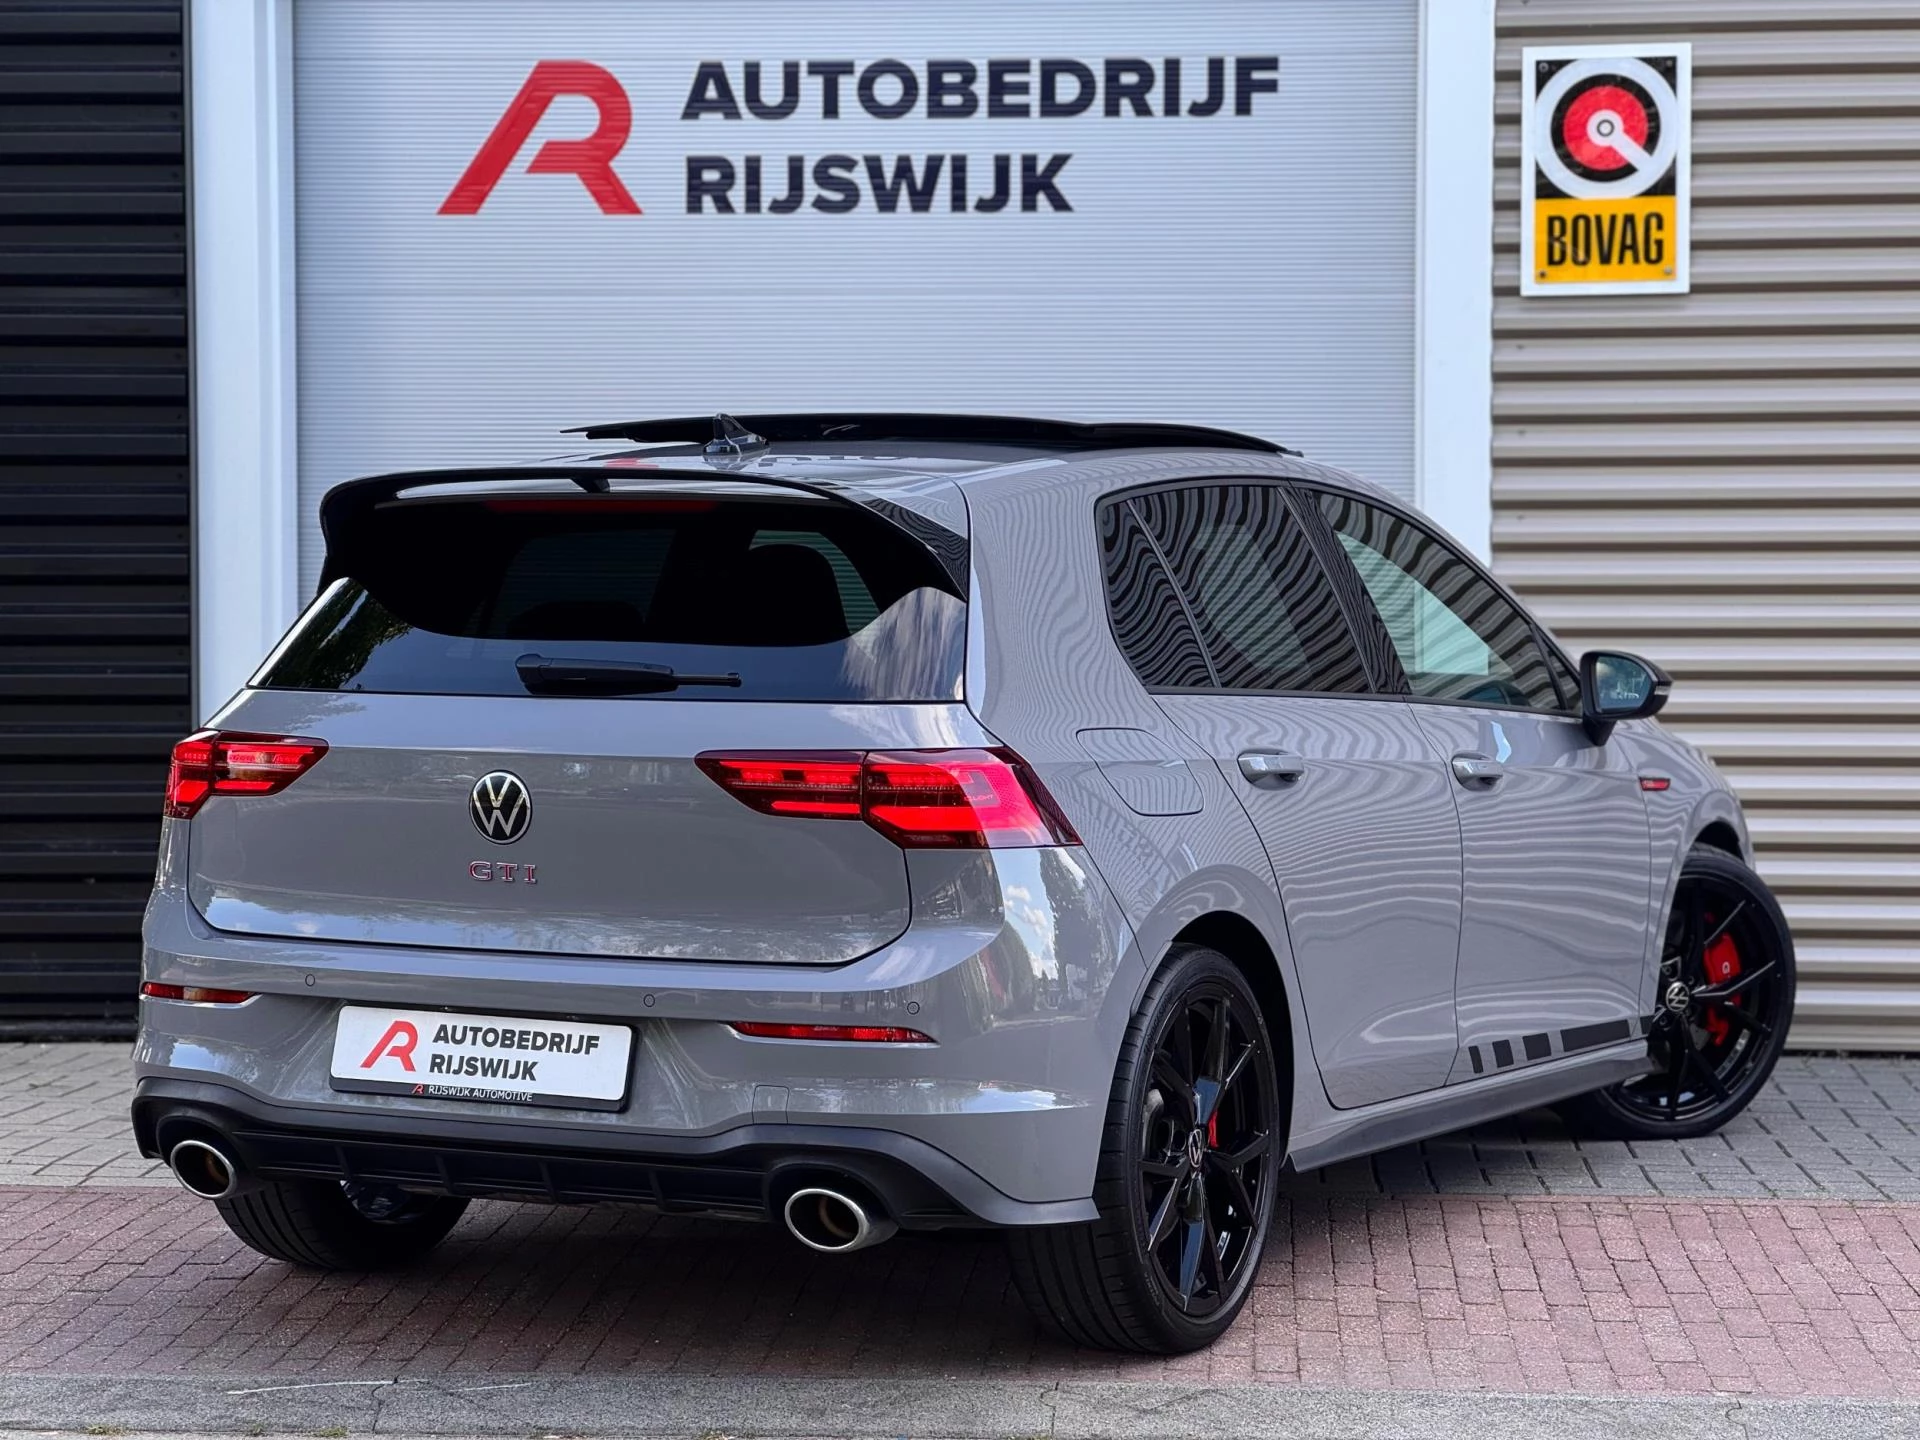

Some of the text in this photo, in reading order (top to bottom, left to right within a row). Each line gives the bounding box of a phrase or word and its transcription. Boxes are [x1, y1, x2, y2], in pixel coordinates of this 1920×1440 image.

[681, 56, 1279, 120] AUTOBEDRIJF
[686, 154, 1074, 214] RIJSWIJK
[1547, 212, 1664, 266] BOVAG
[468, 860, 537, 883] GTI
[432, 1024, 600, 1055] AUTOBEDRIJF
[429, 1054, 538, 1081] RIJSWIJK
[428, 1085, 471, 1097] RIJSWIJK
[472, 1088, 533, 1102] AUTOMOTIVE
